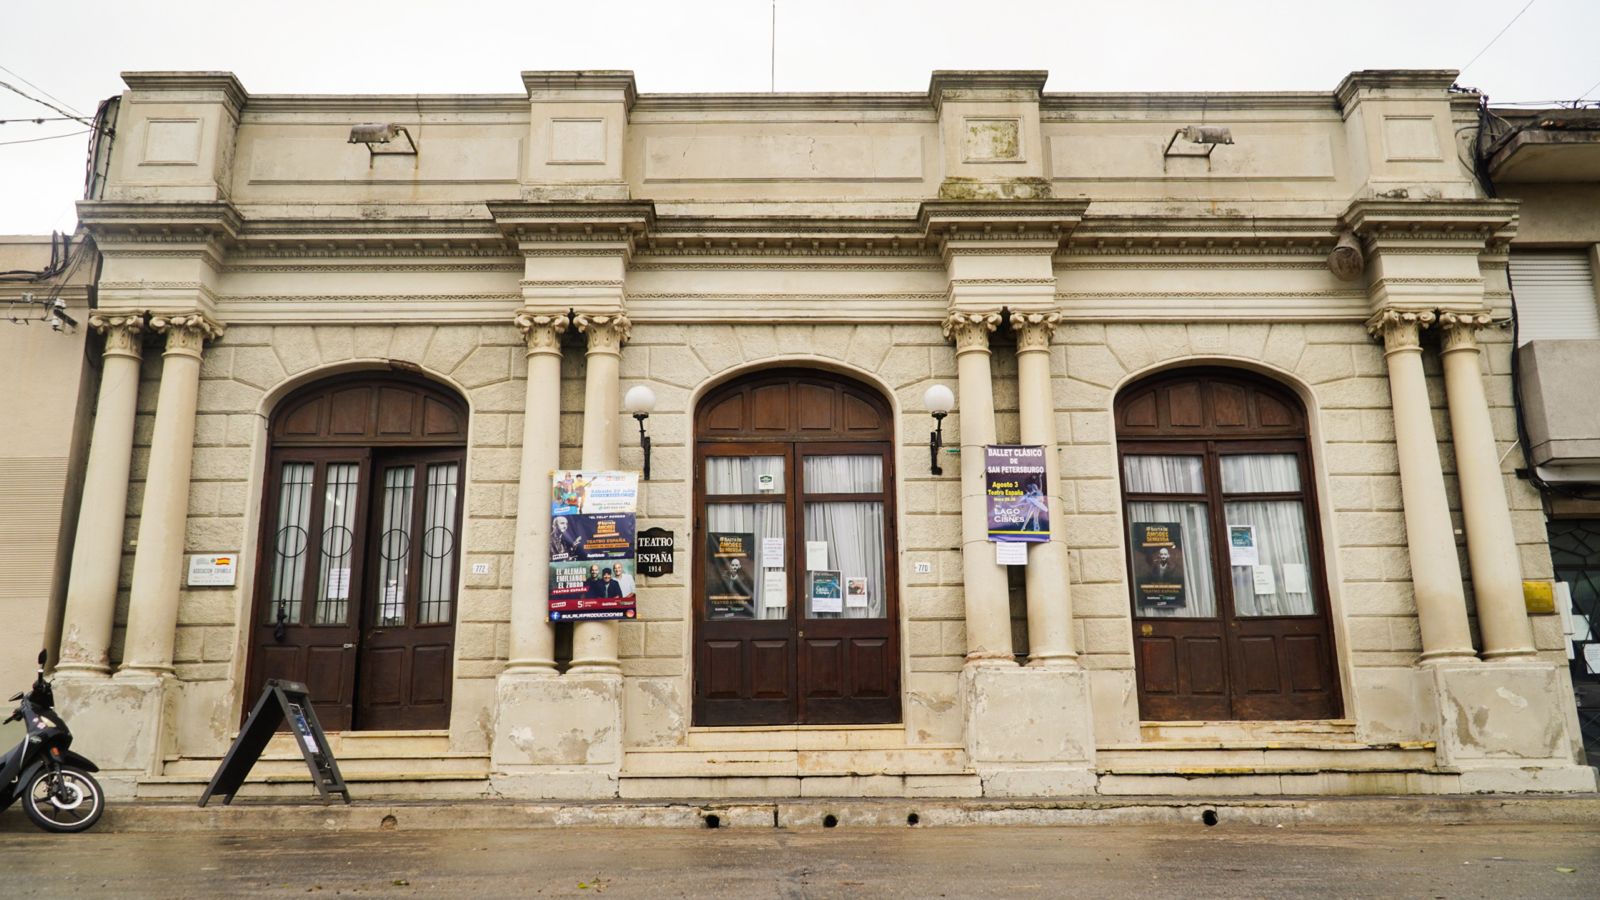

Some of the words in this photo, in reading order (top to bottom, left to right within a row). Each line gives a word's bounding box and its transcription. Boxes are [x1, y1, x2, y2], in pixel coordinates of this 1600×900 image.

[988, 448, 1013, 457] BALLET
[1014, 447, 1043, 457] CLÁSICO
[1010, 457, 1018, 465] DE
[988, 466, 1000, 474] SAN
[1002, 466, 1045, 474] PETERSBURGO
[992, 481, 1013, 489] Agosto
[994, 515, 1025, 523] CISNES
[638, 537, 673, 547] TEATRO
[638, 551, 672, 563] ESPAÑA
